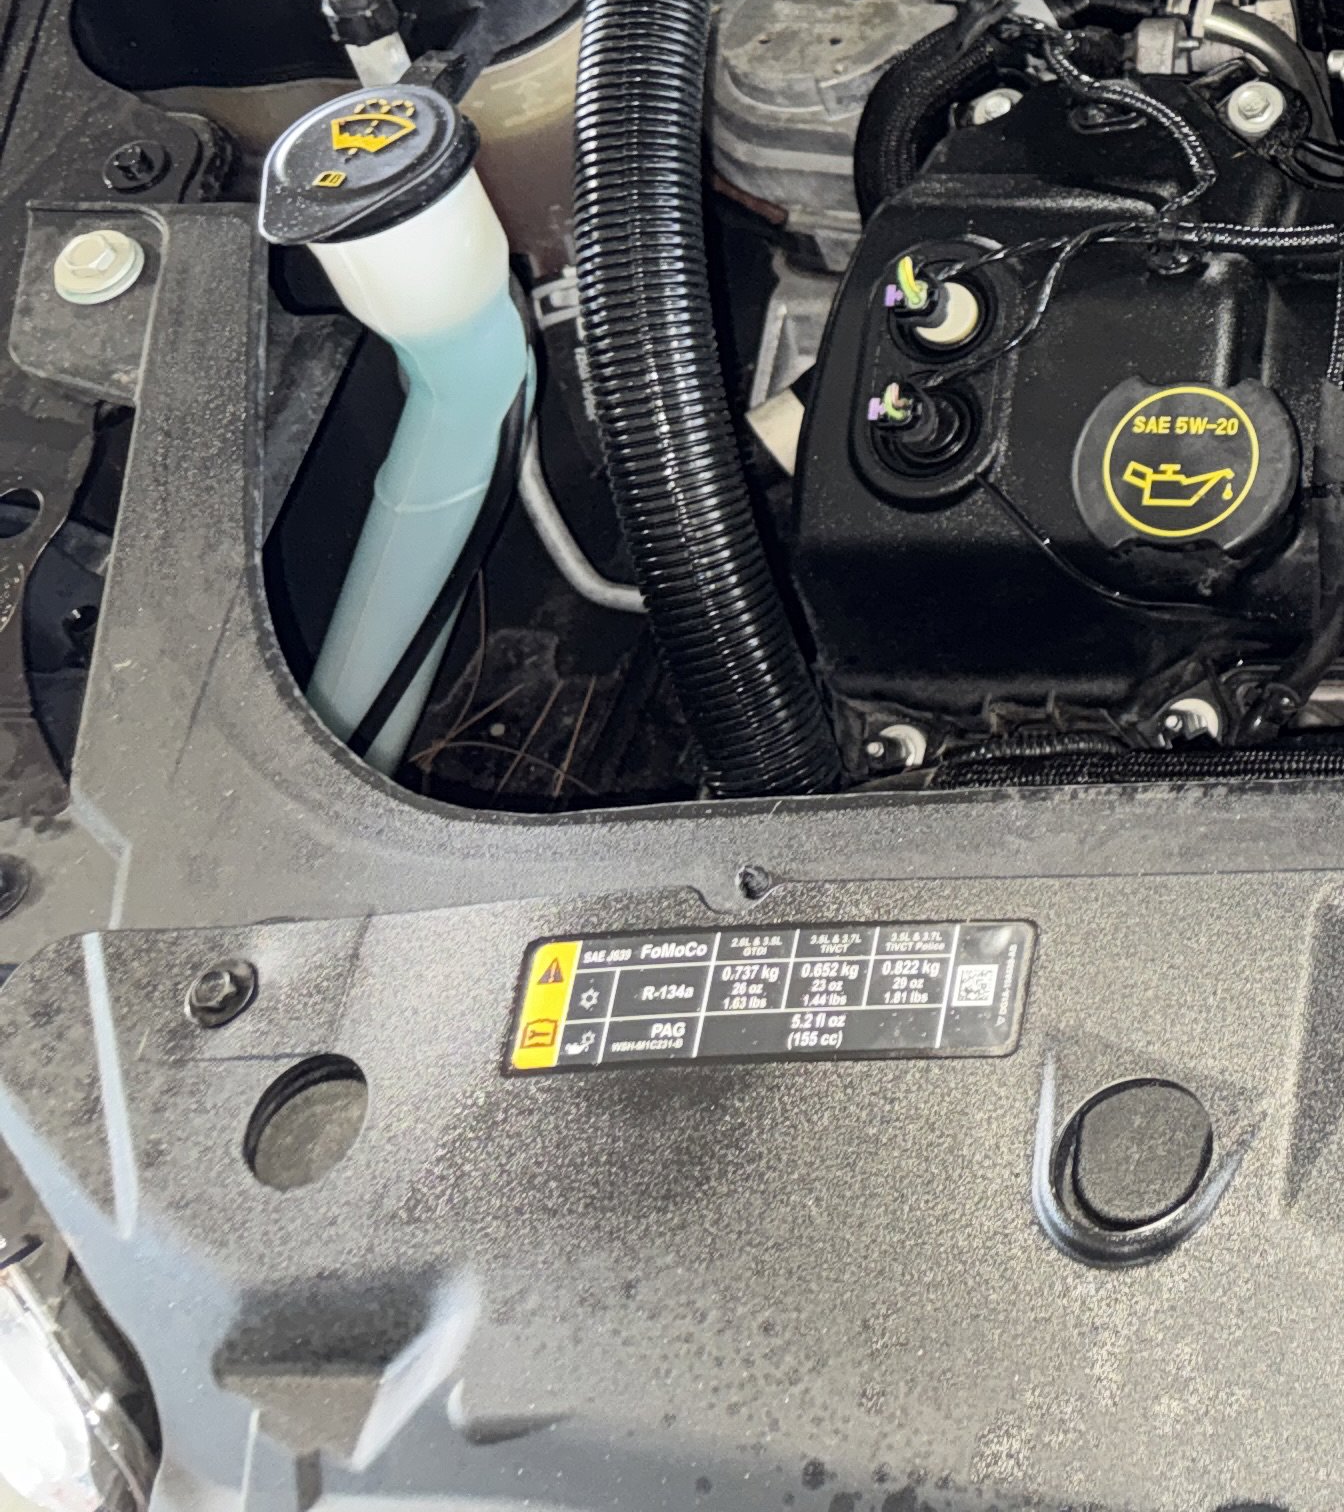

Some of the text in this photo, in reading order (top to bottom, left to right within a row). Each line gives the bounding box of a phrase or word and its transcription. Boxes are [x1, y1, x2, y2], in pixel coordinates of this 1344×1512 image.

[1132, 416, 1239, 436] SAE 5W-20
[583, 950, 606, 963] SAE
[640, 941, 708, 960] FoMoCo
[721, 964, 780, 983] 0.737 kg
[801, 962, 860, 980] 0.652 kg
[881, 959, 941, 978] 0.822 kg
[748, 983, 764, 995] oz
[810, 979, 844, 993] 23 oz
[891, 976, 925, 990] 29 oz
[641, 984, 694, 1001] R-134a
[802, 993, 848, 1007] 1.44 lbs
[883, 991, 929, 1004] 1.81 lbs
[749, 996, 767, 1009] lbs
[651, 1021, 687, 1038] PAG
[790, 1013, 847, 1029] 5.2 fl oz
[787, 1029, 843, 1051] (155 cc)
